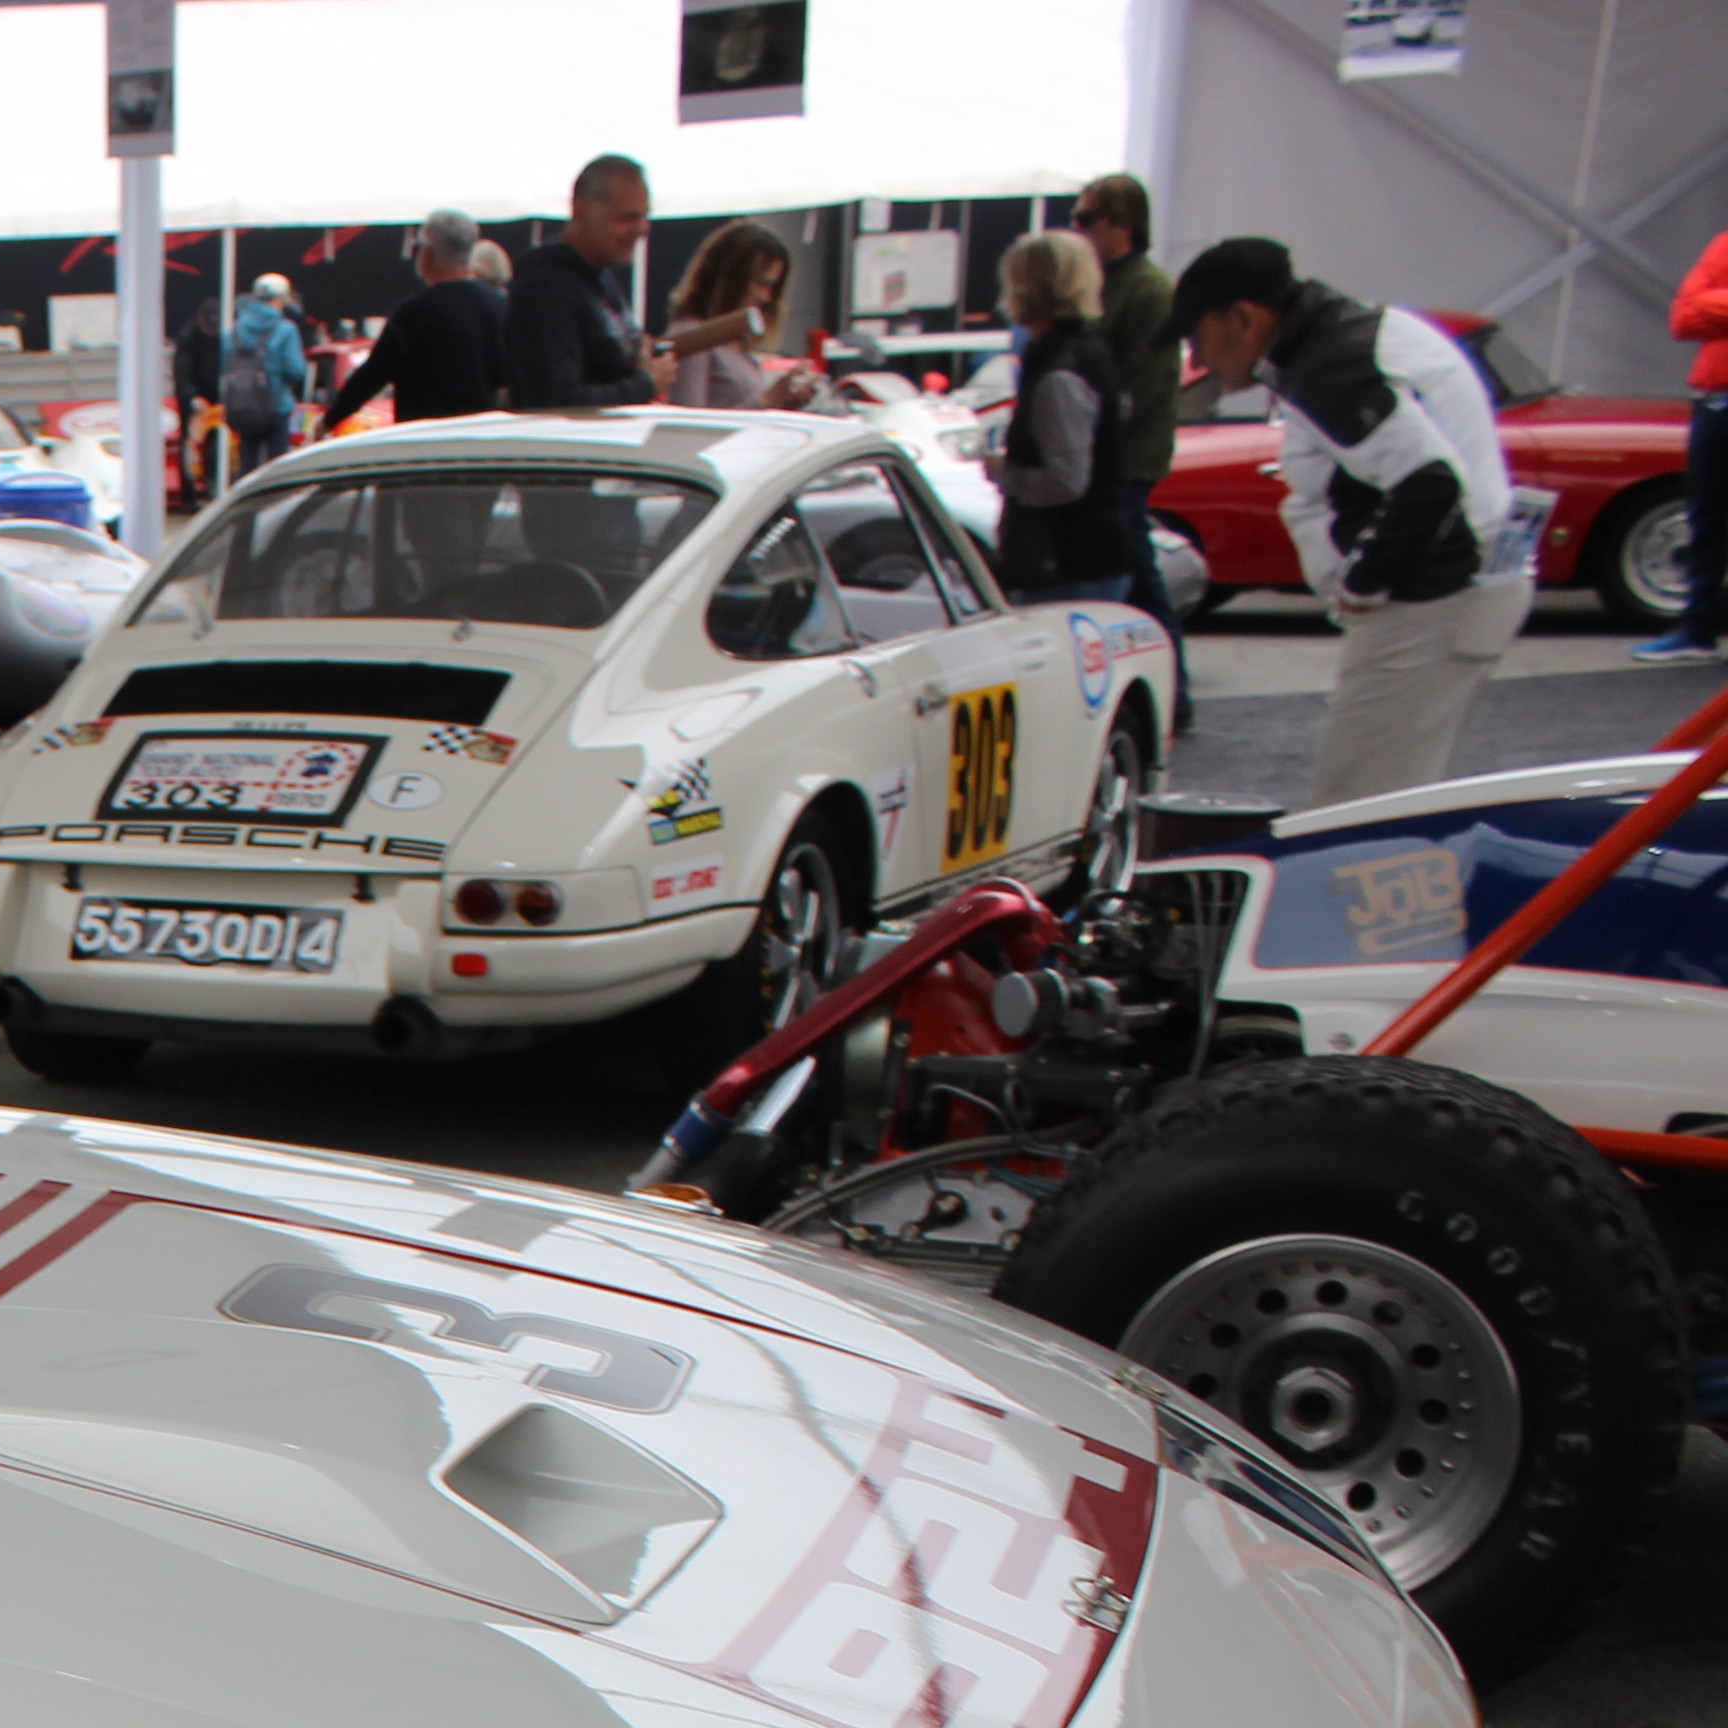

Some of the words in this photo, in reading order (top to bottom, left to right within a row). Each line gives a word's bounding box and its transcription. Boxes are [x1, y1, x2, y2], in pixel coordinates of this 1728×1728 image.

[124, 783, 242, 810] 303
[391, 775, 423, 805] F
[946, 688, 1017, 861] 303
[216, 1262, 696, 1415] 3
